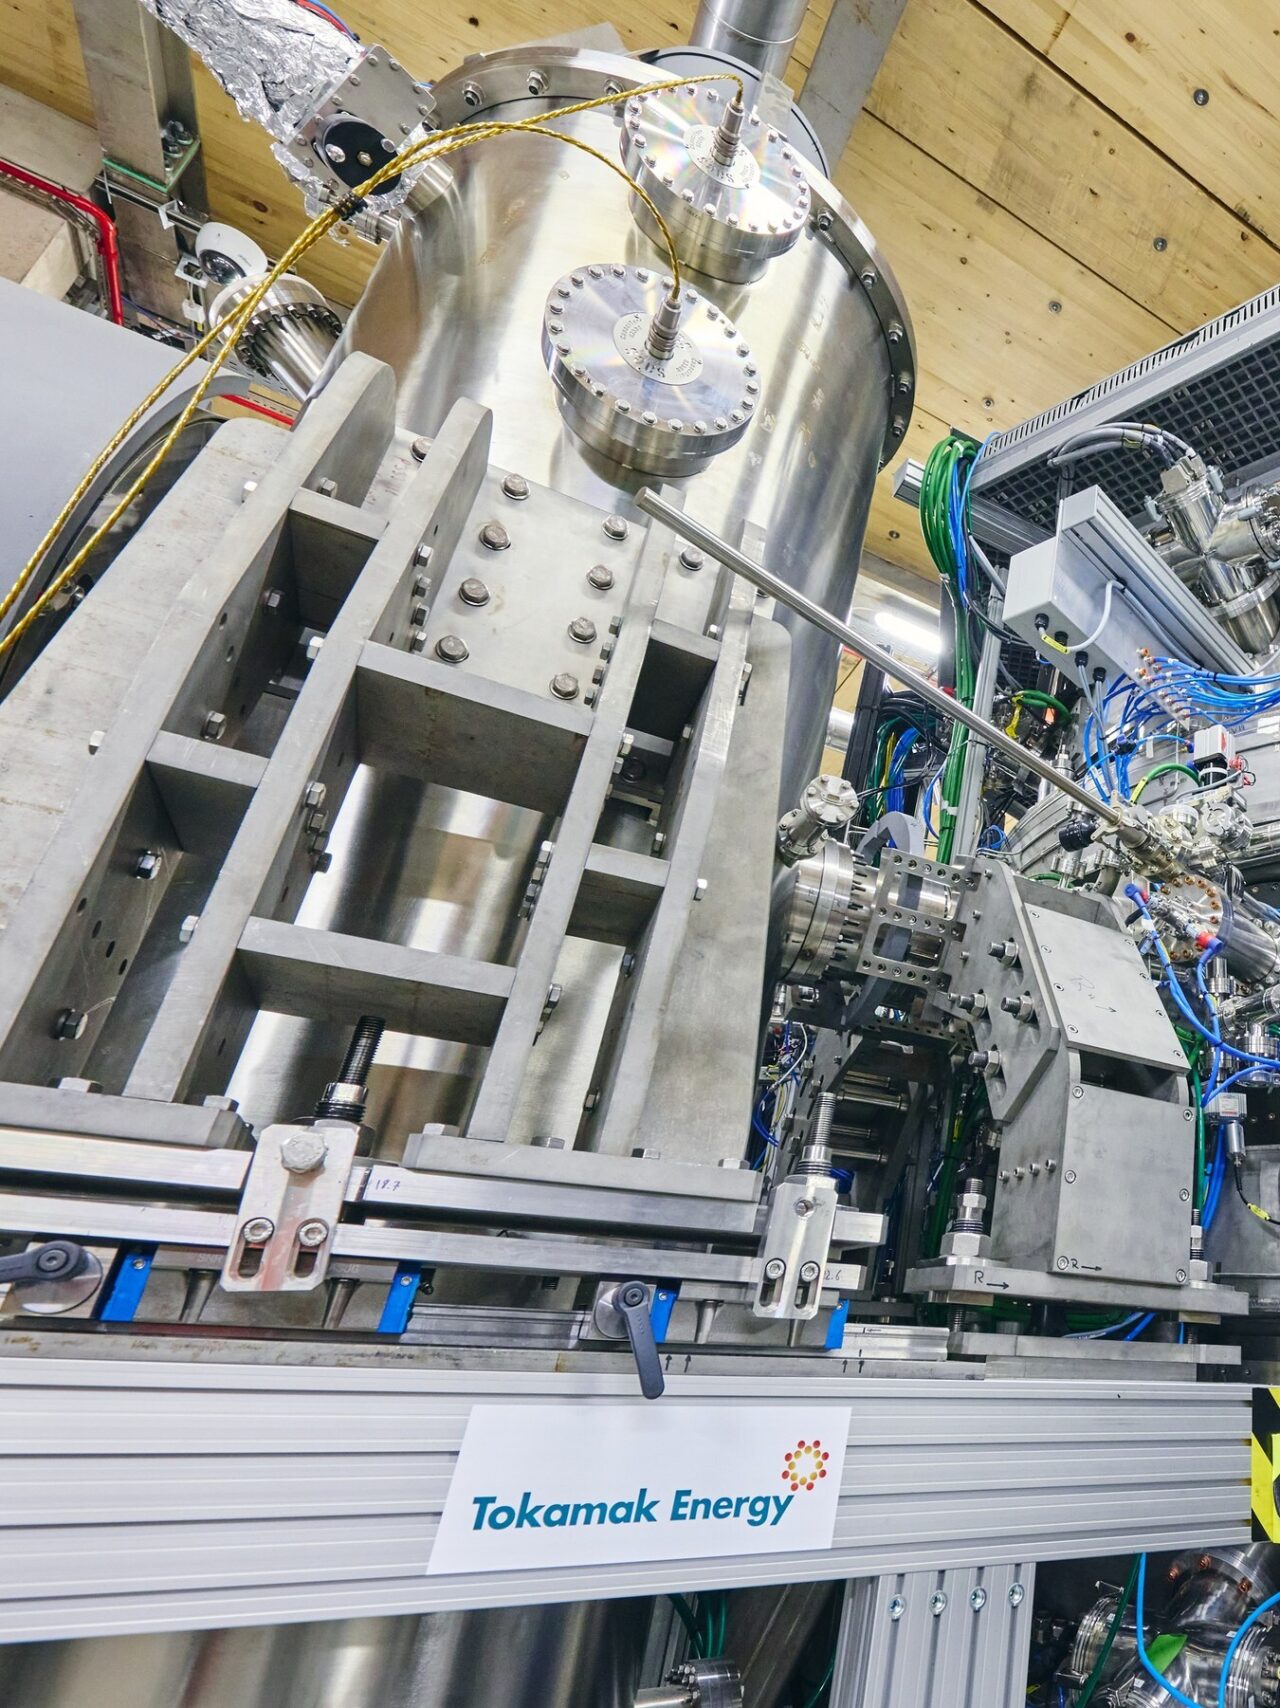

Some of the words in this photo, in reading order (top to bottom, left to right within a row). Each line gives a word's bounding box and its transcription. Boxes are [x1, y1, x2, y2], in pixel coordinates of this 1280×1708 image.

[1070, 1258, 1079, 1269] R
[974, 1270, 984, 1284] R
[472, 1488, 660, 1530] Tokamak
[670, 1489, 795, 1527] Energy
